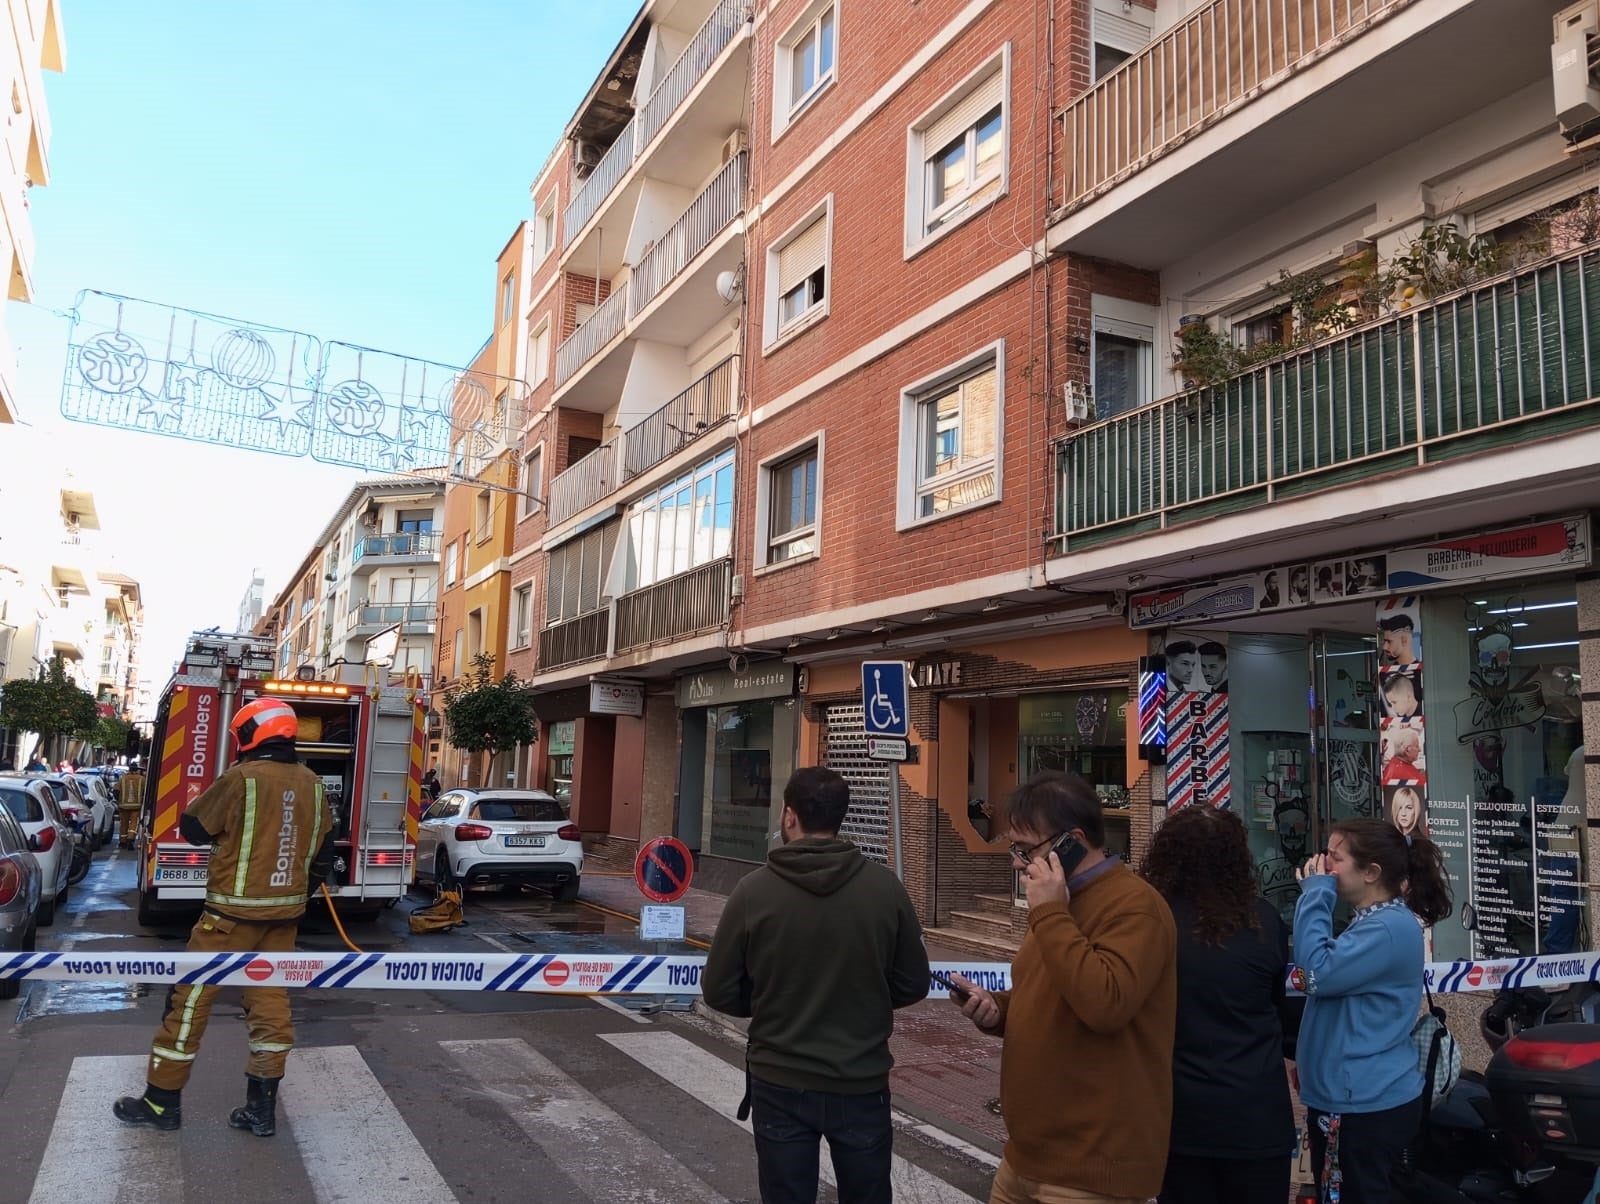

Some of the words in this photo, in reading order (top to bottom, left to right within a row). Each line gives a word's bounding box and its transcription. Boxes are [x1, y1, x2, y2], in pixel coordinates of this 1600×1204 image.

[187, 694, 212, 777] Bombers
[1428, 800, 1467, 809] BARBERIA
[1474, 802, 1527, 812] PELUQUERIA
[1536, 804, 1580, 814] ESTETICA
[1427, 818, 1459, 826] CORTES
[269, 789, 296, 887] Bombers
[1473, 847, 1499, 855] Mechas
[162, 870, 188, 880] 8688
[1477, 924, 1505, 933] einados
[63, 961, 112, 974] LOCAL
[117, 961, 176, 975] POLICIA
[385, 962, 427, 980] LOCAL
[432, 962, 484, 981] POLICIA
[1537, 961, 1558, 978] LOCAL
[1558, 959, 1586, 977] POLICIA
